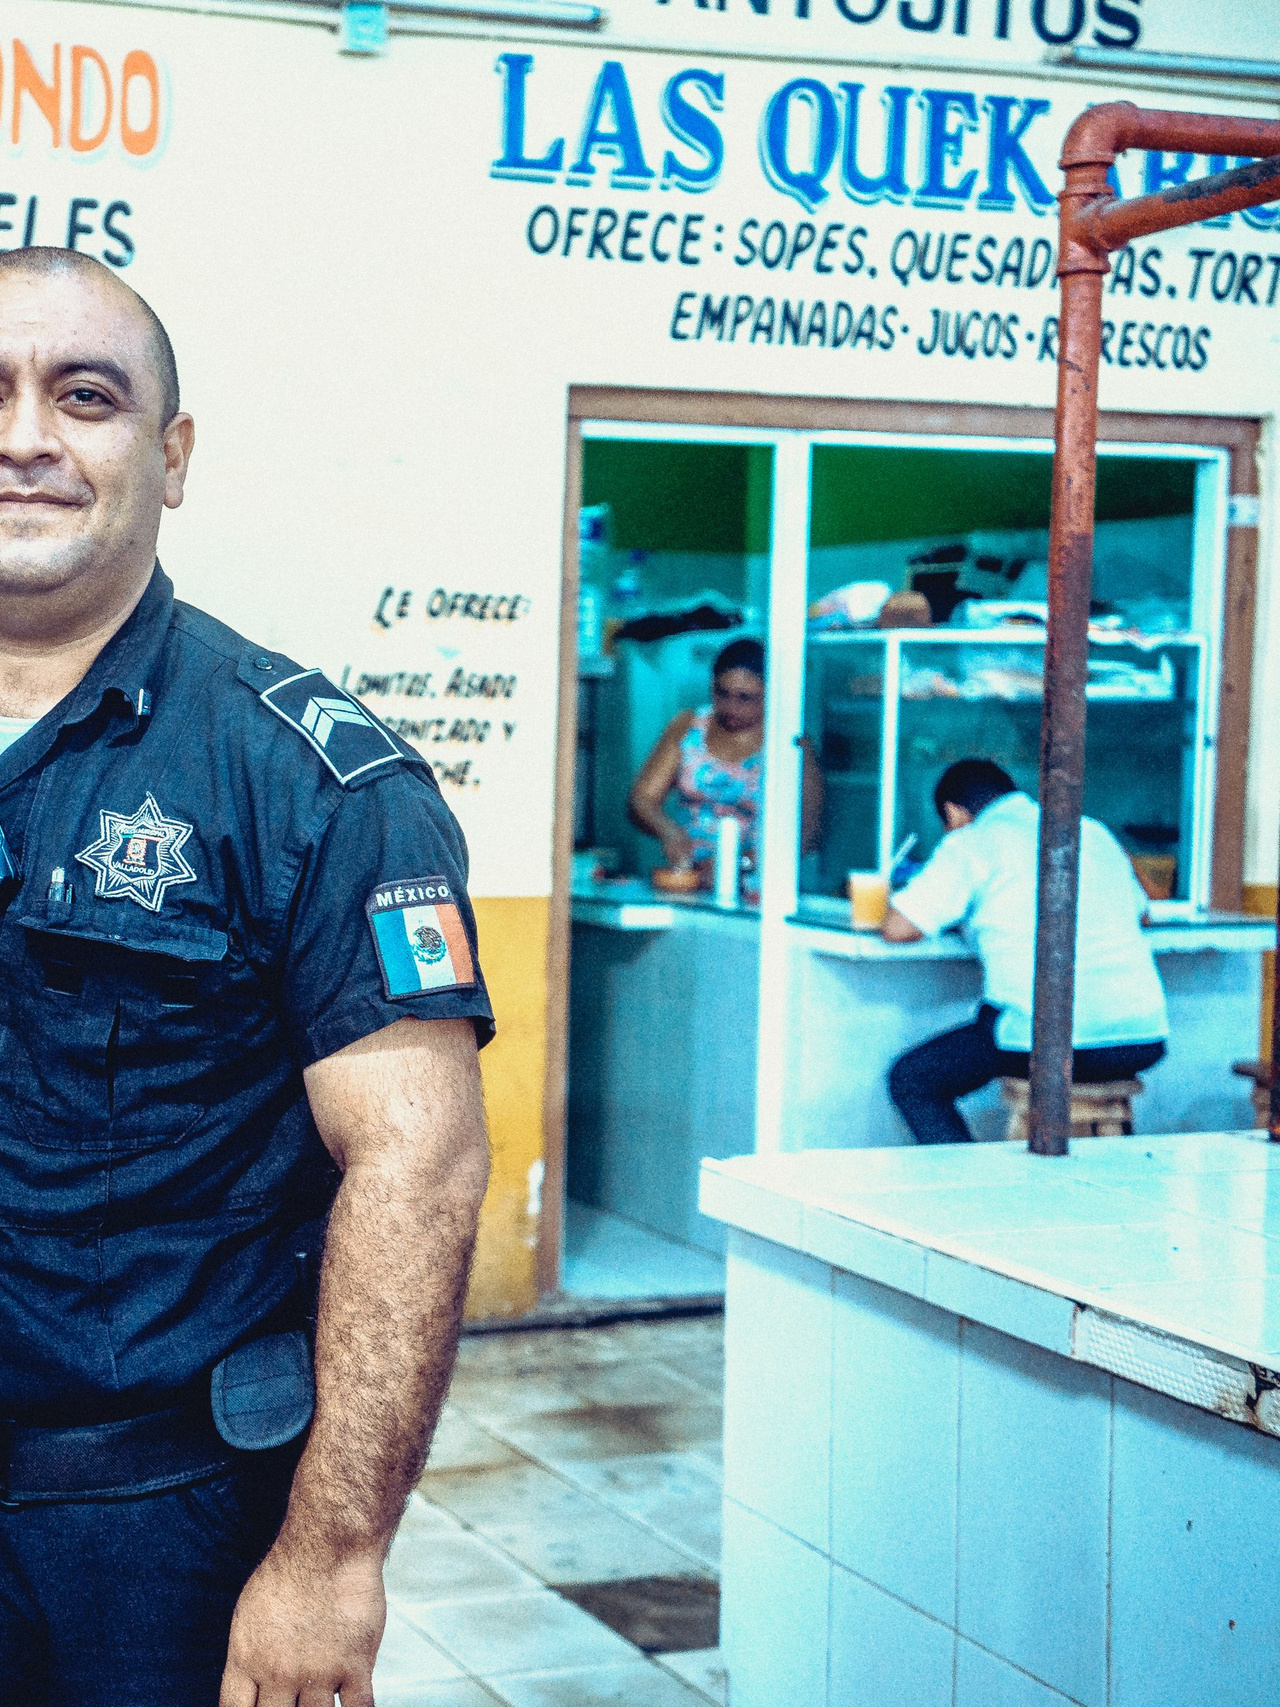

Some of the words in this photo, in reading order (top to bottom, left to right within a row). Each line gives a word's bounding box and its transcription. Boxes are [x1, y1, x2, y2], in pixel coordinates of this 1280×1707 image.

[490, 52, 724, 189] LAS
[526, 203, 724, 265] OFRECE:
[669, 290, 897, 352] EMPANADAS
[373, 585, 413, 630] LE
[112, 861, 154, 875] VALLADOLID
[376, 886, 449, 906] MÉXICO
